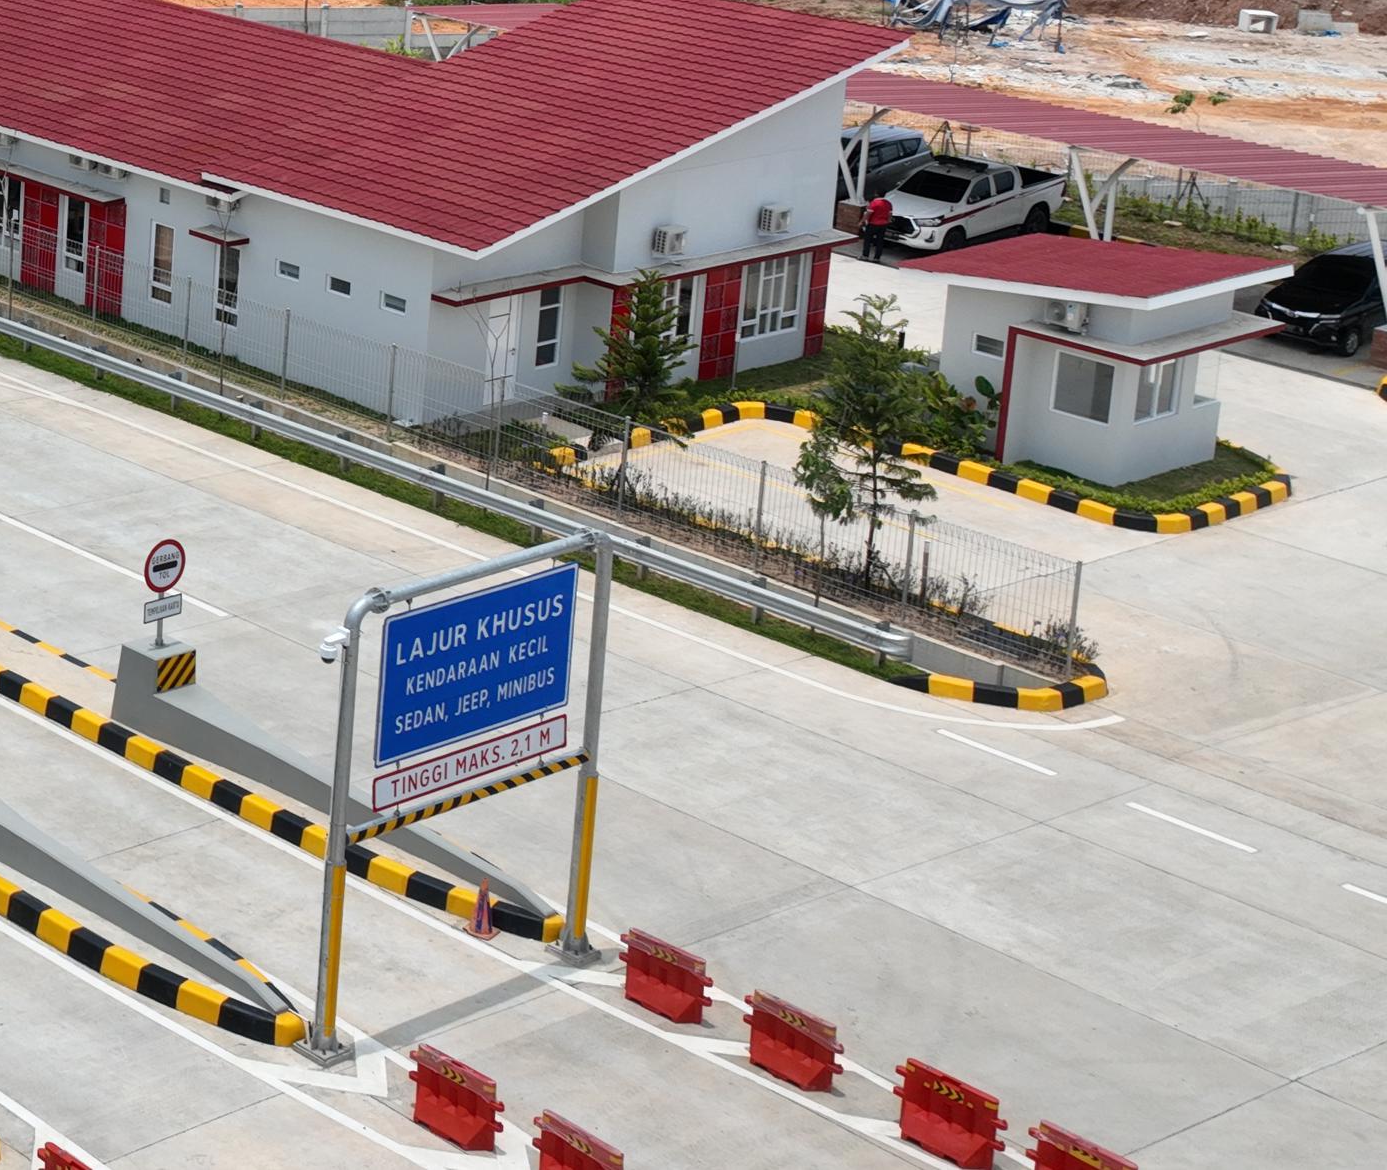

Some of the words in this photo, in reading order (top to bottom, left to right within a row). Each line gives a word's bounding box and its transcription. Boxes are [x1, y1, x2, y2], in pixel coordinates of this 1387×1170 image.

[395, 623, 467, 666] LAJUR
[477, 594, 564, 640] KHUSUS
[406, 650, 500, 696] KENDARAAN
[508, 635, 548, 664] KECIL
[395, 702, 449, 734] SEDAN,
[454, 688, 490, 717] JEEP,
[496, 667, 555, 702] MINIBUS
[391, 762, 448, 798] TINGGI
[455, 745, 505, 776] MAKS.
[510, 734, 531, 758] 2,1
[539, 727, 550, 748] M
